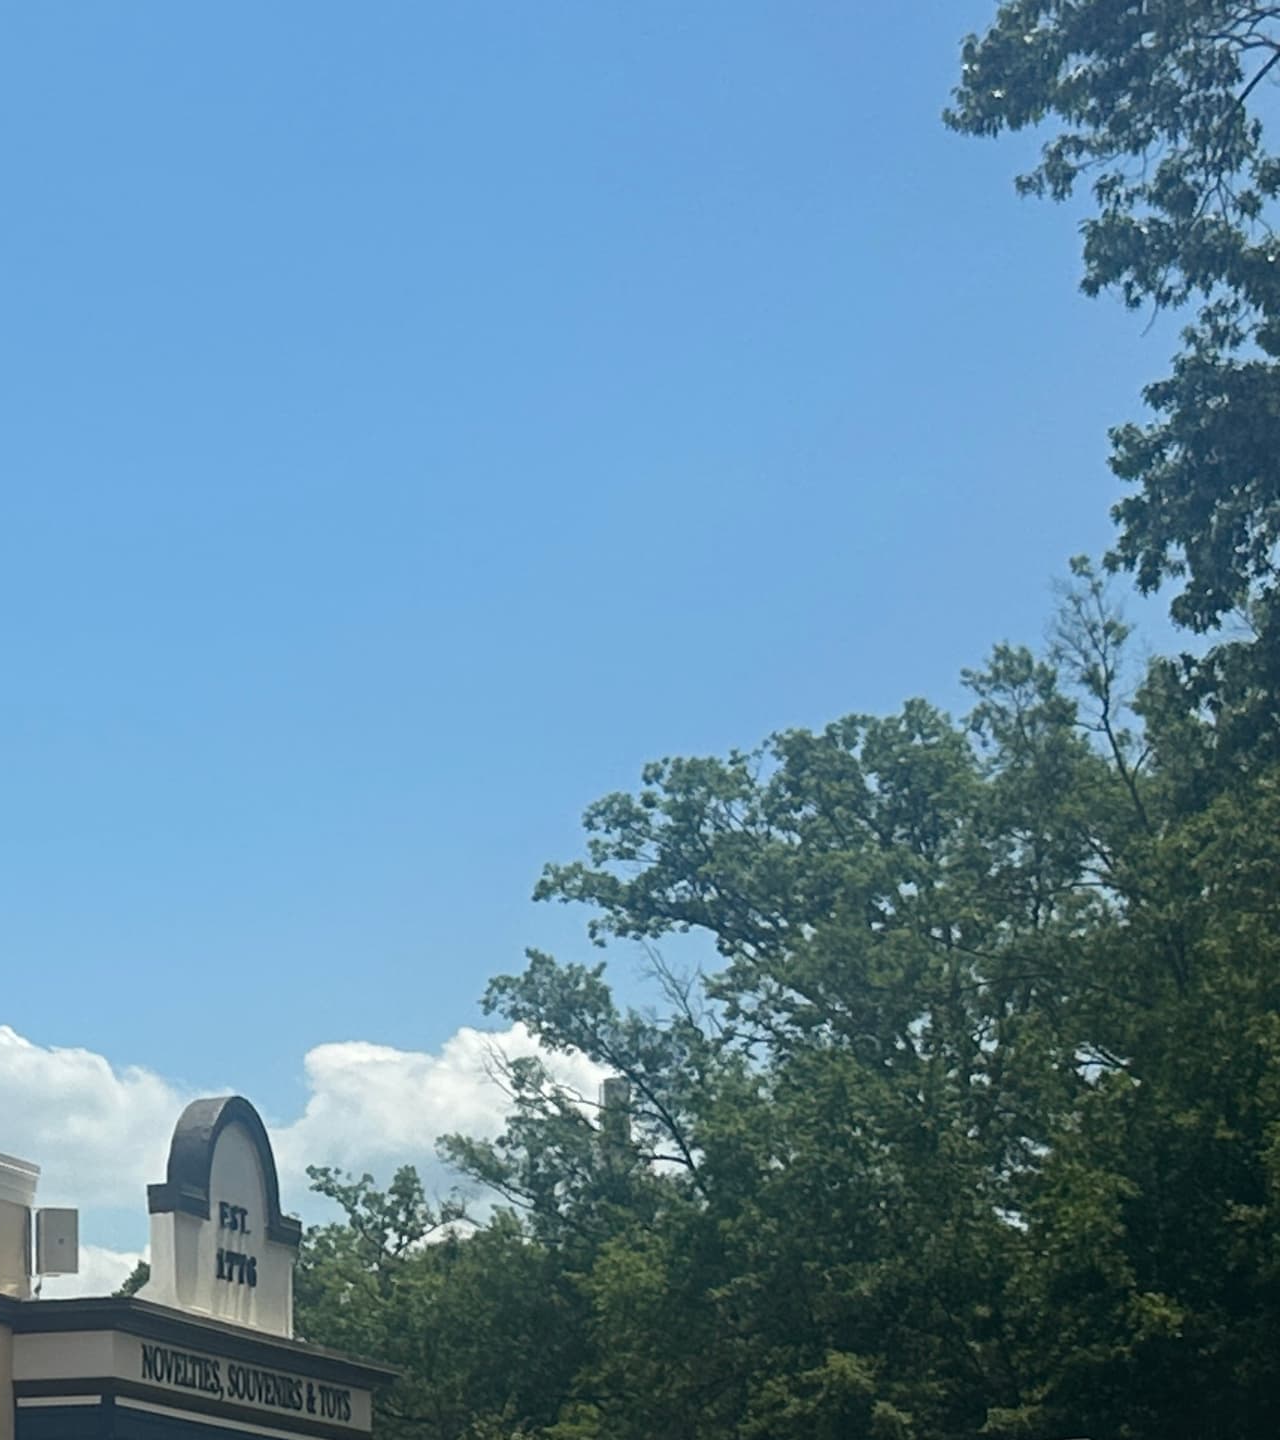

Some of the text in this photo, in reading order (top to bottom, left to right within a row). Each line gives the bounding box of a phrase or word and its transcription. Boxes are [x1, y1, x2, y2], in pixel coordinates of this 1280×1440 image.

[219, 1201, 251, 1234] EST.
[216, 1248, 257, 1288] 1776
[141, 1344, 352, 1422] NOVELTIES, SOUVENIRS & TOYS
